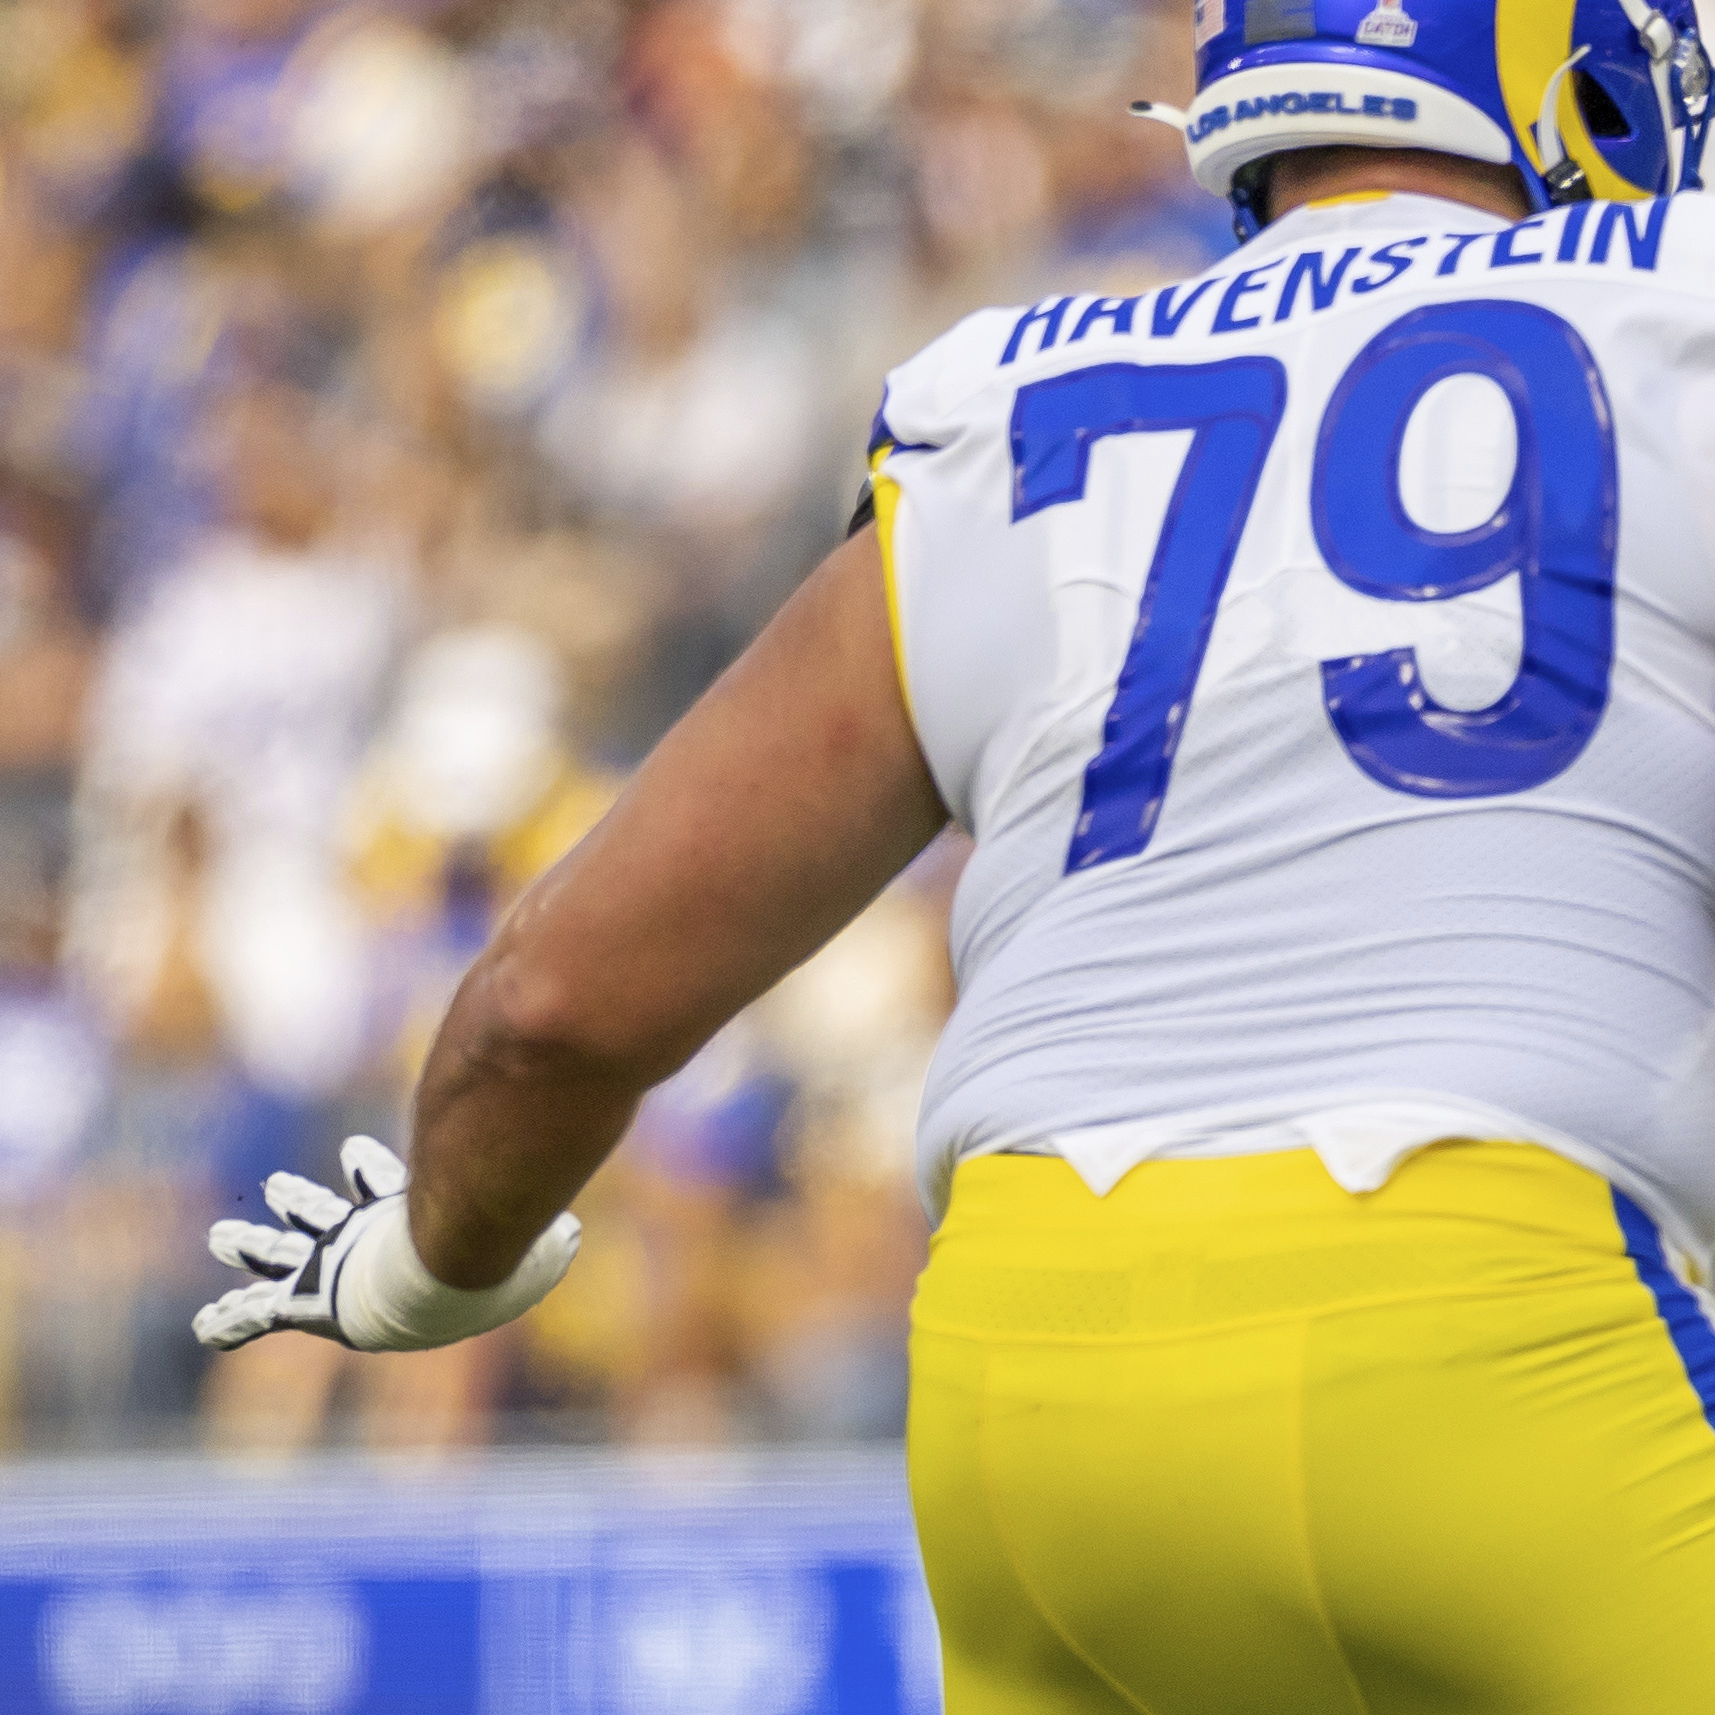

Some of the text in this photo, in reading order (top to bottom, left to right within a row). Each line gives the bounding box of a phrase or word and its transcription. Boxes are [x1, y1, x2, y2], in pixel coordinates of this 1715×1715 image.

[1187, 92, 1417, 144] LOS ANGELES
[997, 198, 1665, 367] HAVENSTEIN
[1010, 298, 1620, 878] 79
